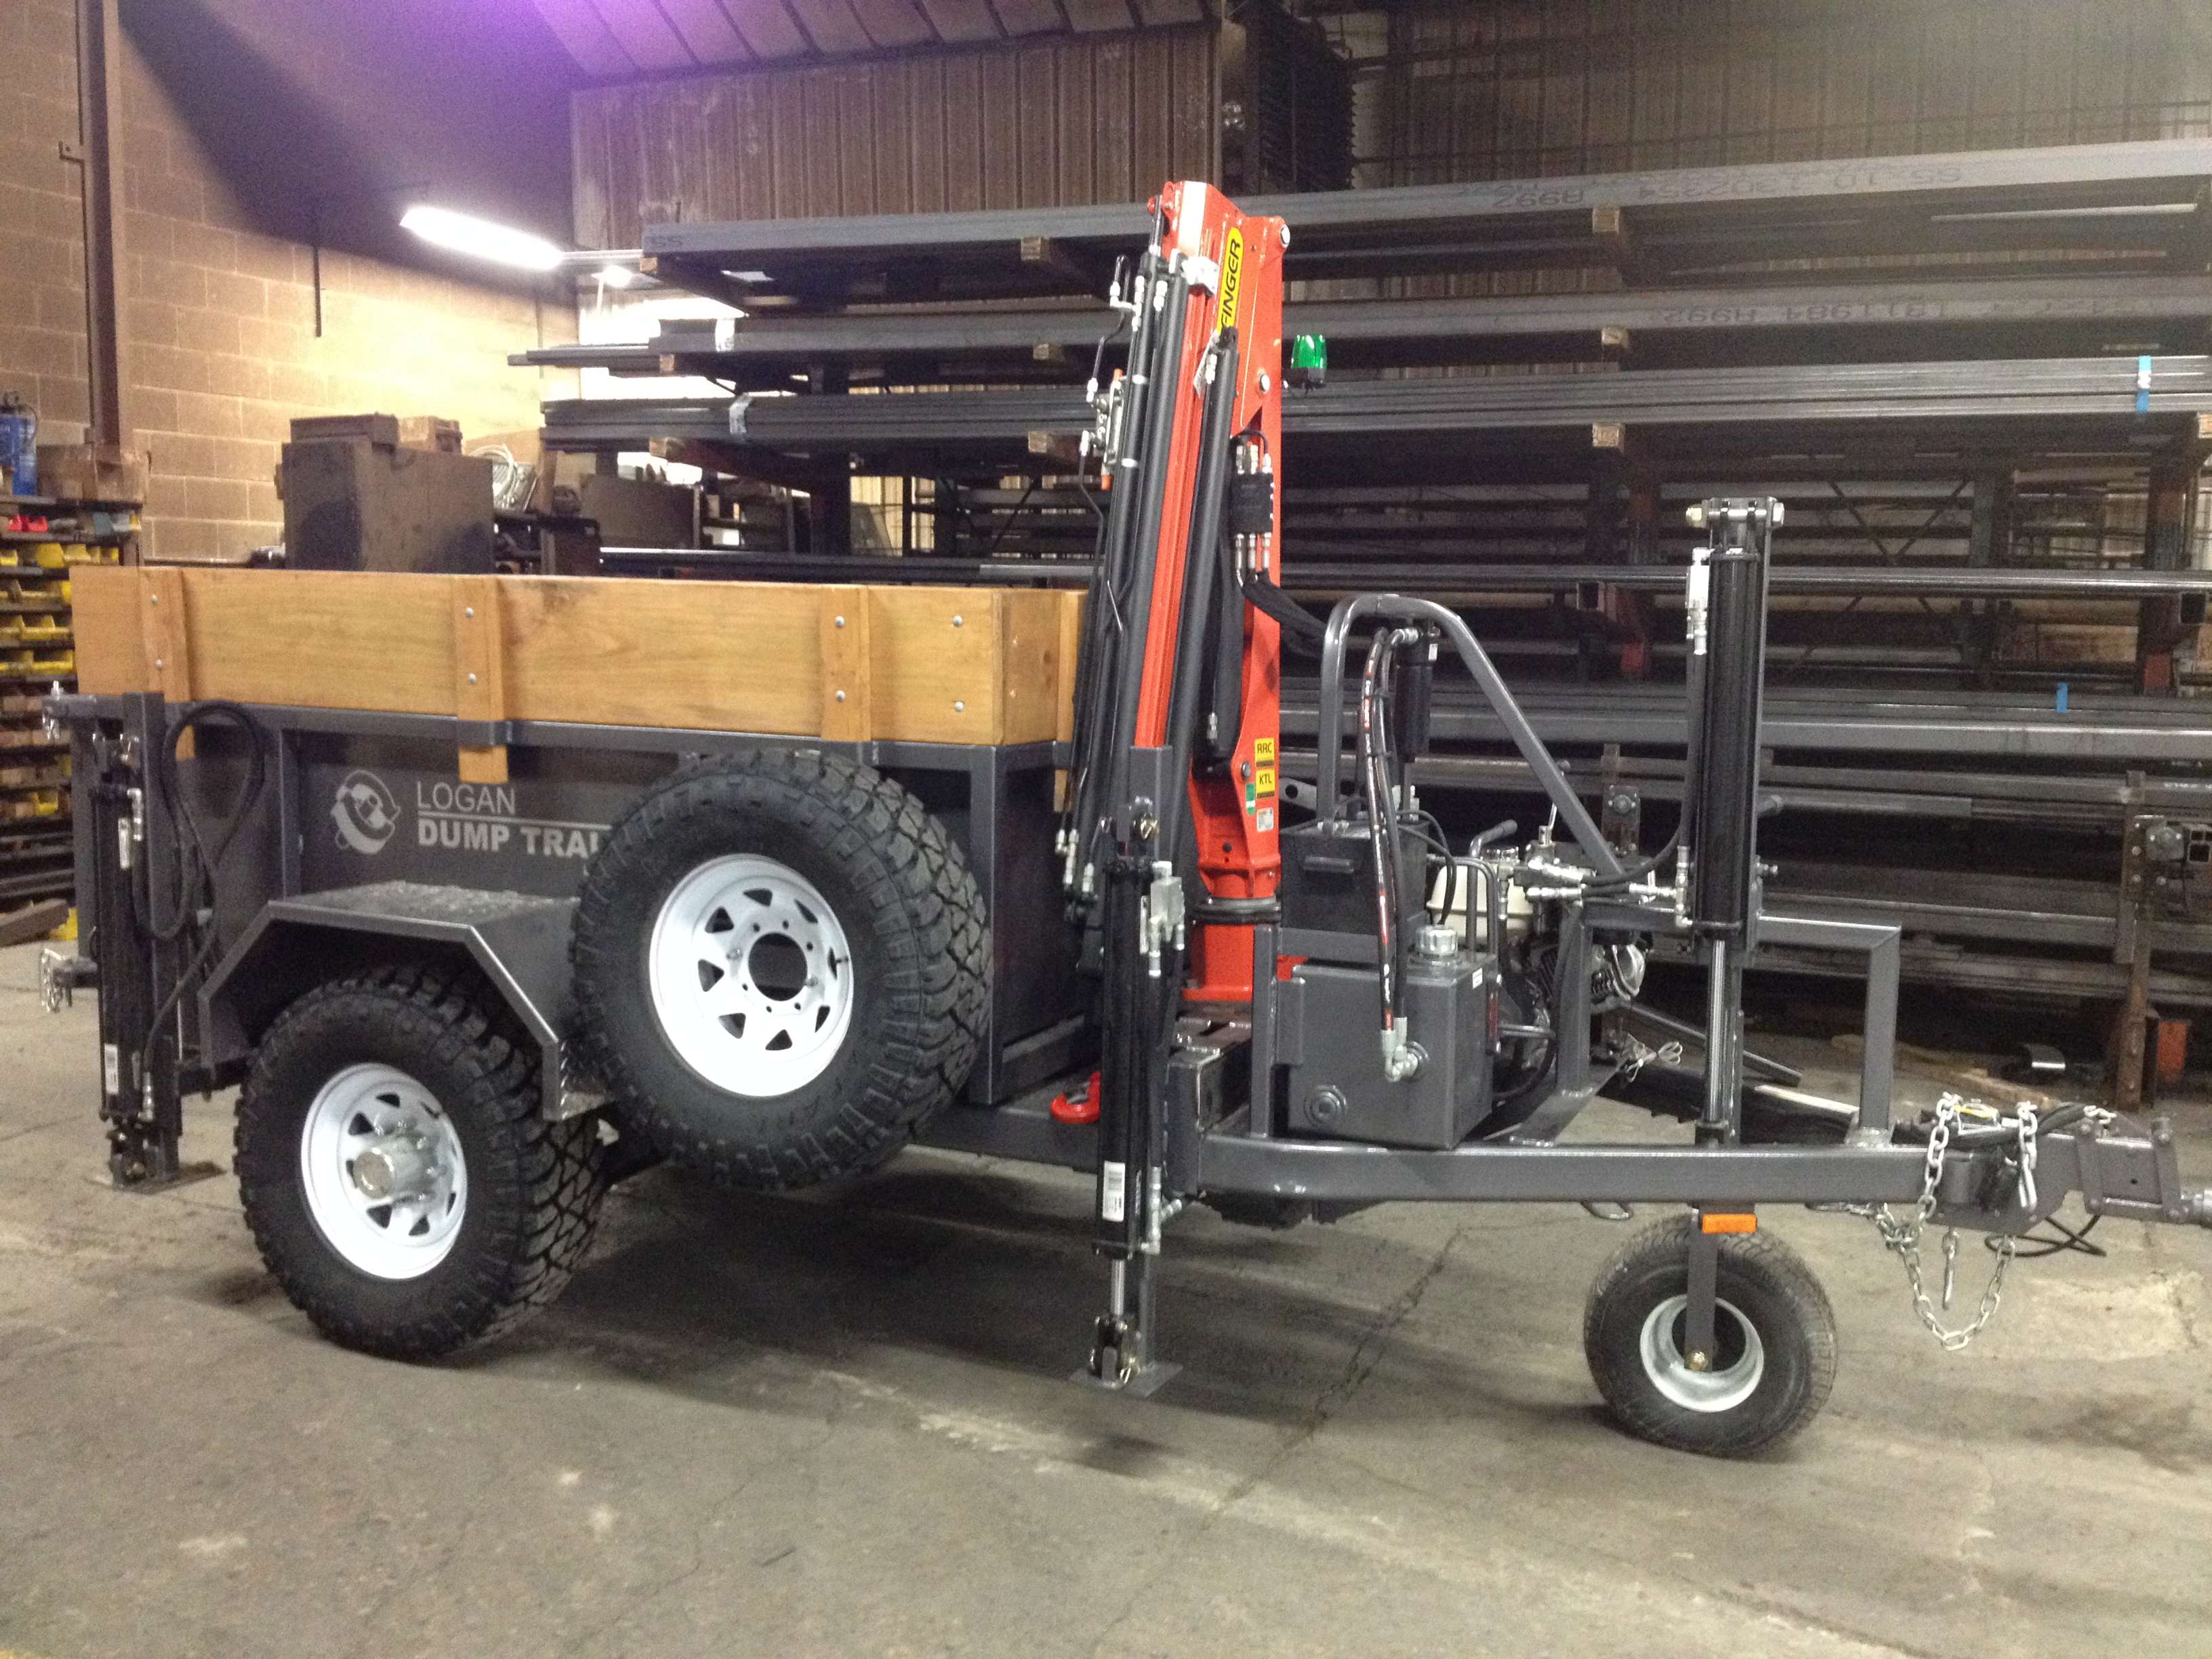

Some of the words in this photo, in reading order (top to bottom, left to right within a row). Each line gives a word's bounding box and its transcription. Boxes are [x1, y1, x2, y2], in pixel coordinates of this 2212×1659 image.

[1257, 742, 1272, 754] RRC
[1259, 773, 1272, 785] KTL
[417, 781, 515, 814] LOGAN
[418, 818, 509, 851] DUMP
